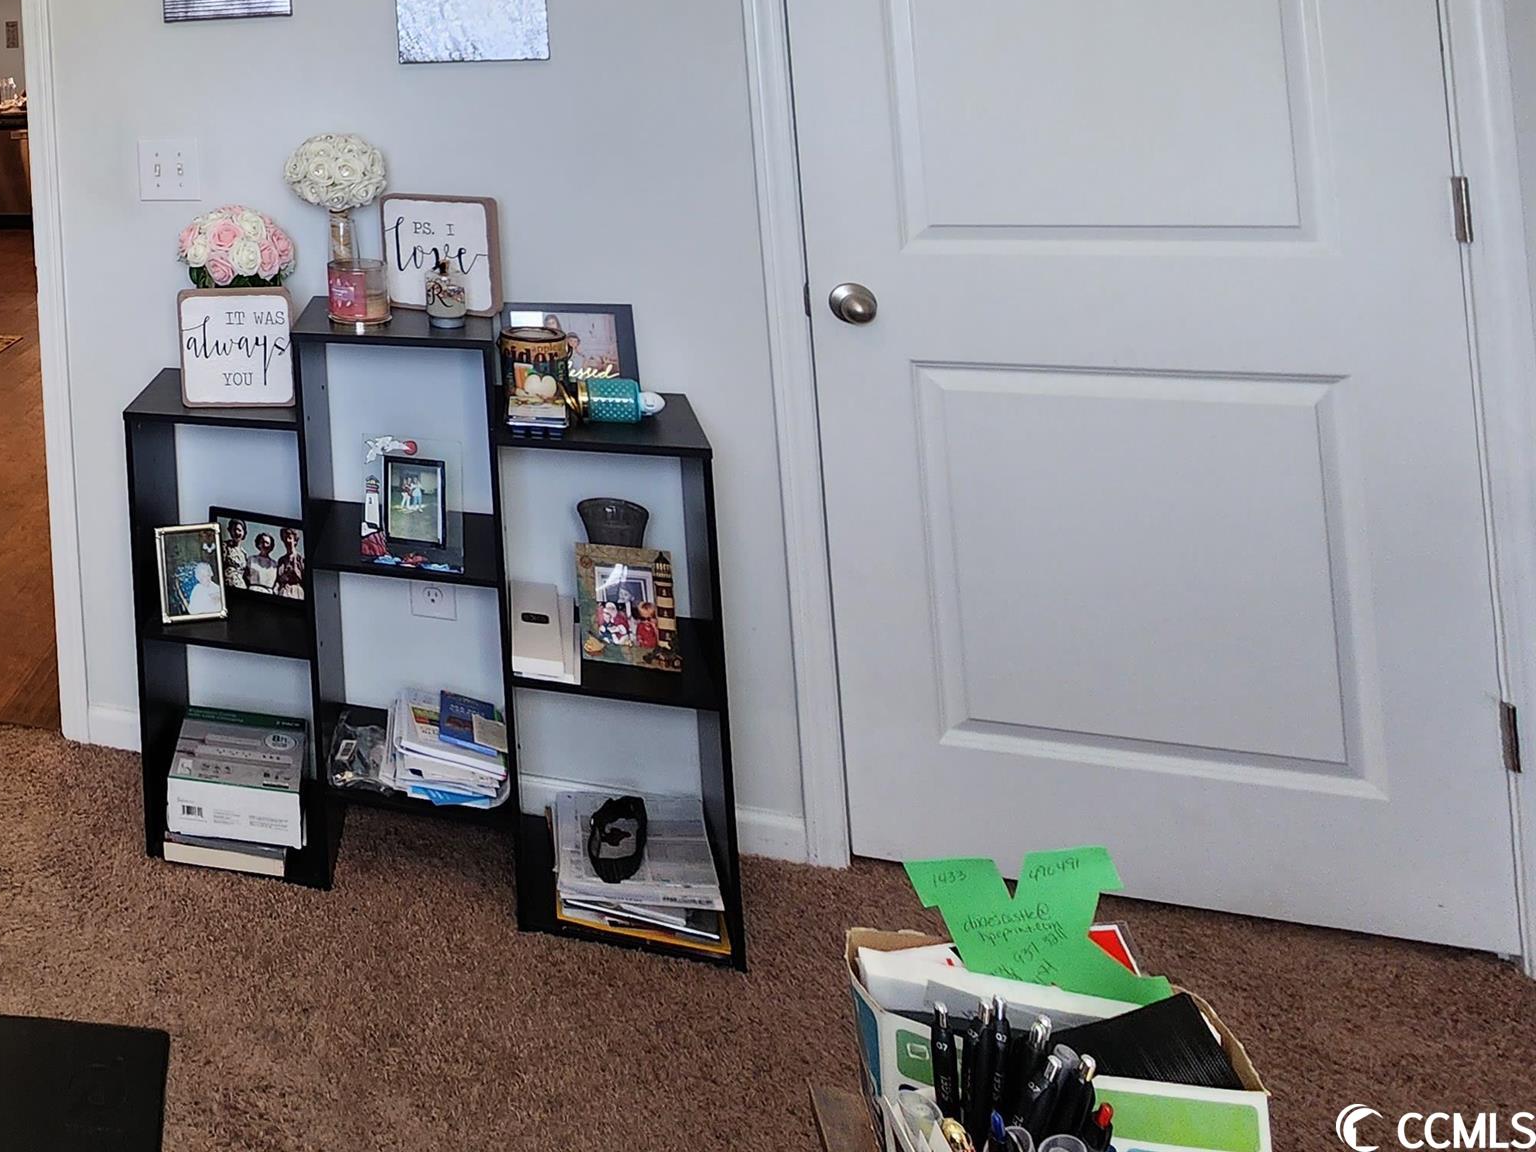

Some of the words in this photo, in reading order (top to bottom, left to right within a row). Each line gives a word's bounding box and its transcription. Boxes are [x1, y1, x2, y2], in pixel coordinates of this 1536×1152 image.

[385, 216, 488, 275] love
[225, 311, 246, 325] IT
[253, 311, 285, 325] WAS
[180, 315, 293, 386] always
[222, 372, 253, 386] YOU
